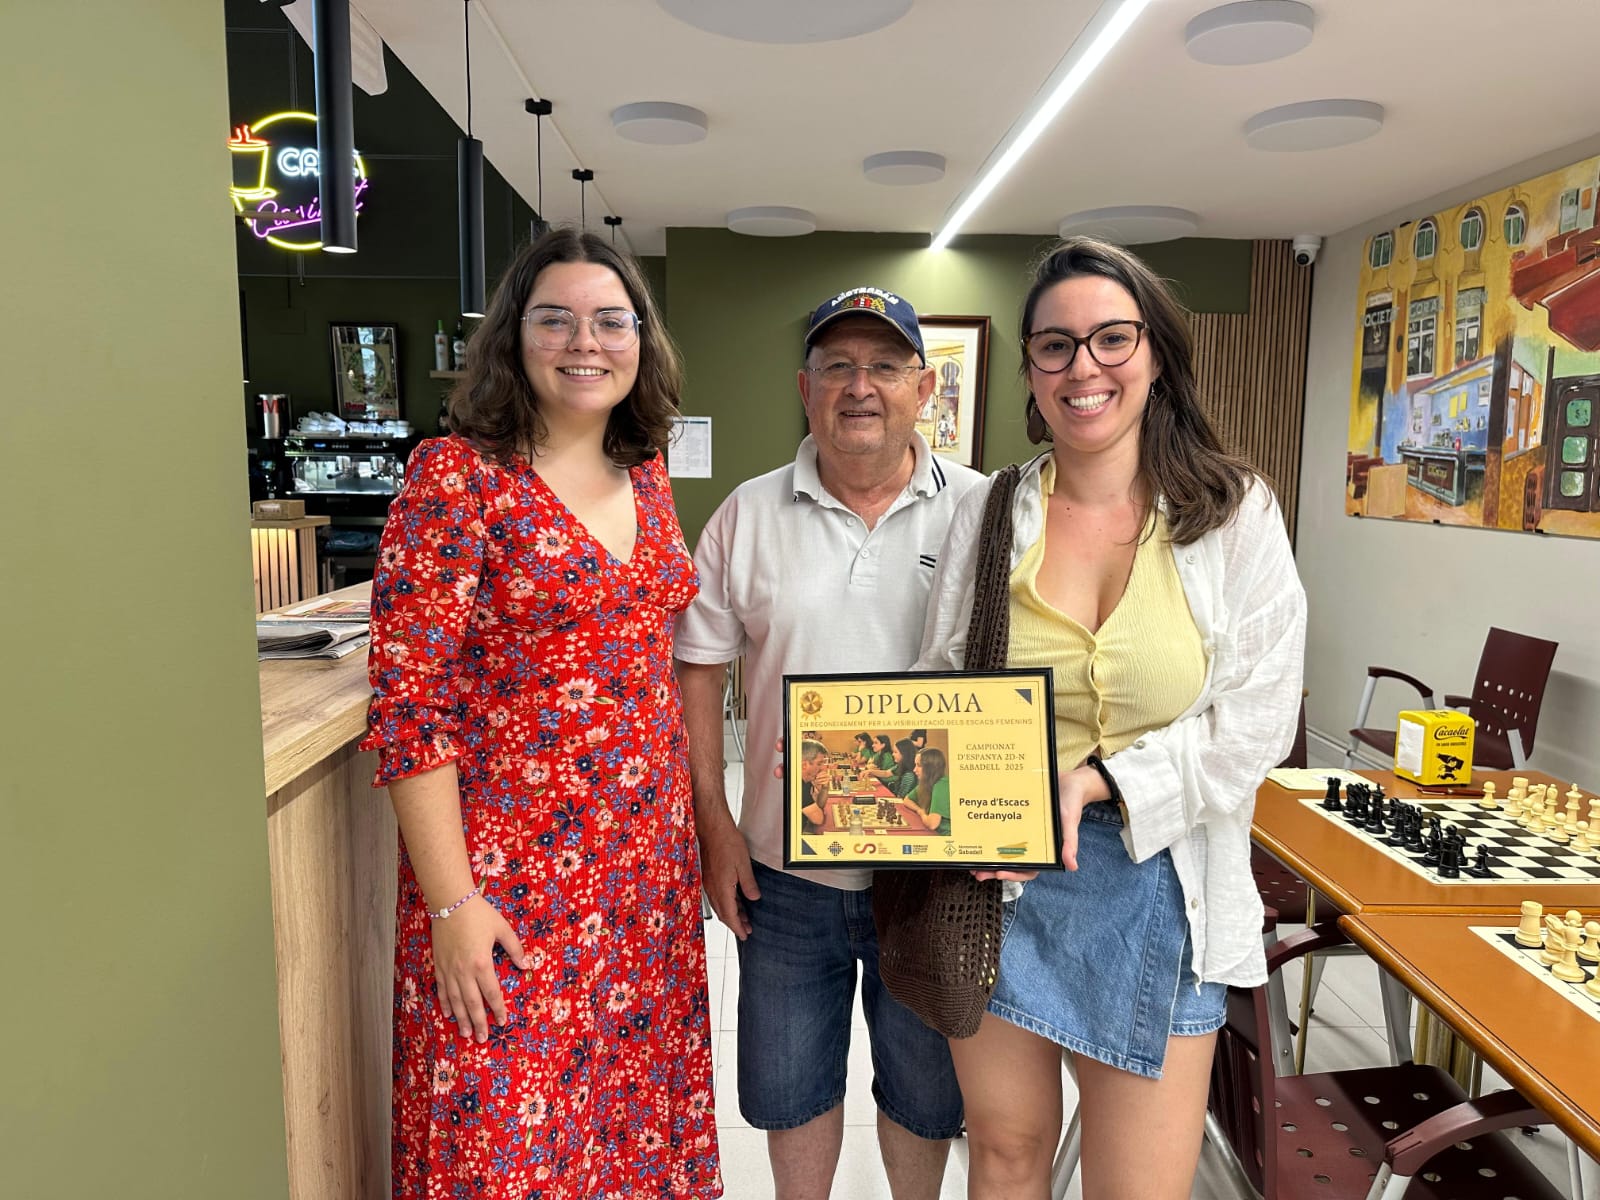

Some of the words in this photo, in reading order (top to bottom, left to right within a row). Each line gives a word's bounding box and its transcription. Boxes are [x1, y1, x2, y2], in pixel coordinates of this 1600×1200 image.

[845, 692, 983, 715] DIPLOMA
[810, 720, 866, 728] RECONEIXEMENT
[893, 718, 945, 727] VISIBILITZACIÓ
[1434, 725, 1470, 740] Cacaolat
[966, 743, 1016, 751] CAMPIONAT
[957, 753, 1003, 761] D'ESPANYA
[1004, 753, 1025, 761] 2D-N
[959, 763, 1000, 771] SABADELL
[1004, 763, 1024, 771] 2025
[959, 798, 988, 808] Penya
[990, 797, 1030, 807] d'Escacs
[967, 811, 1022, 821] Cerdanyola
